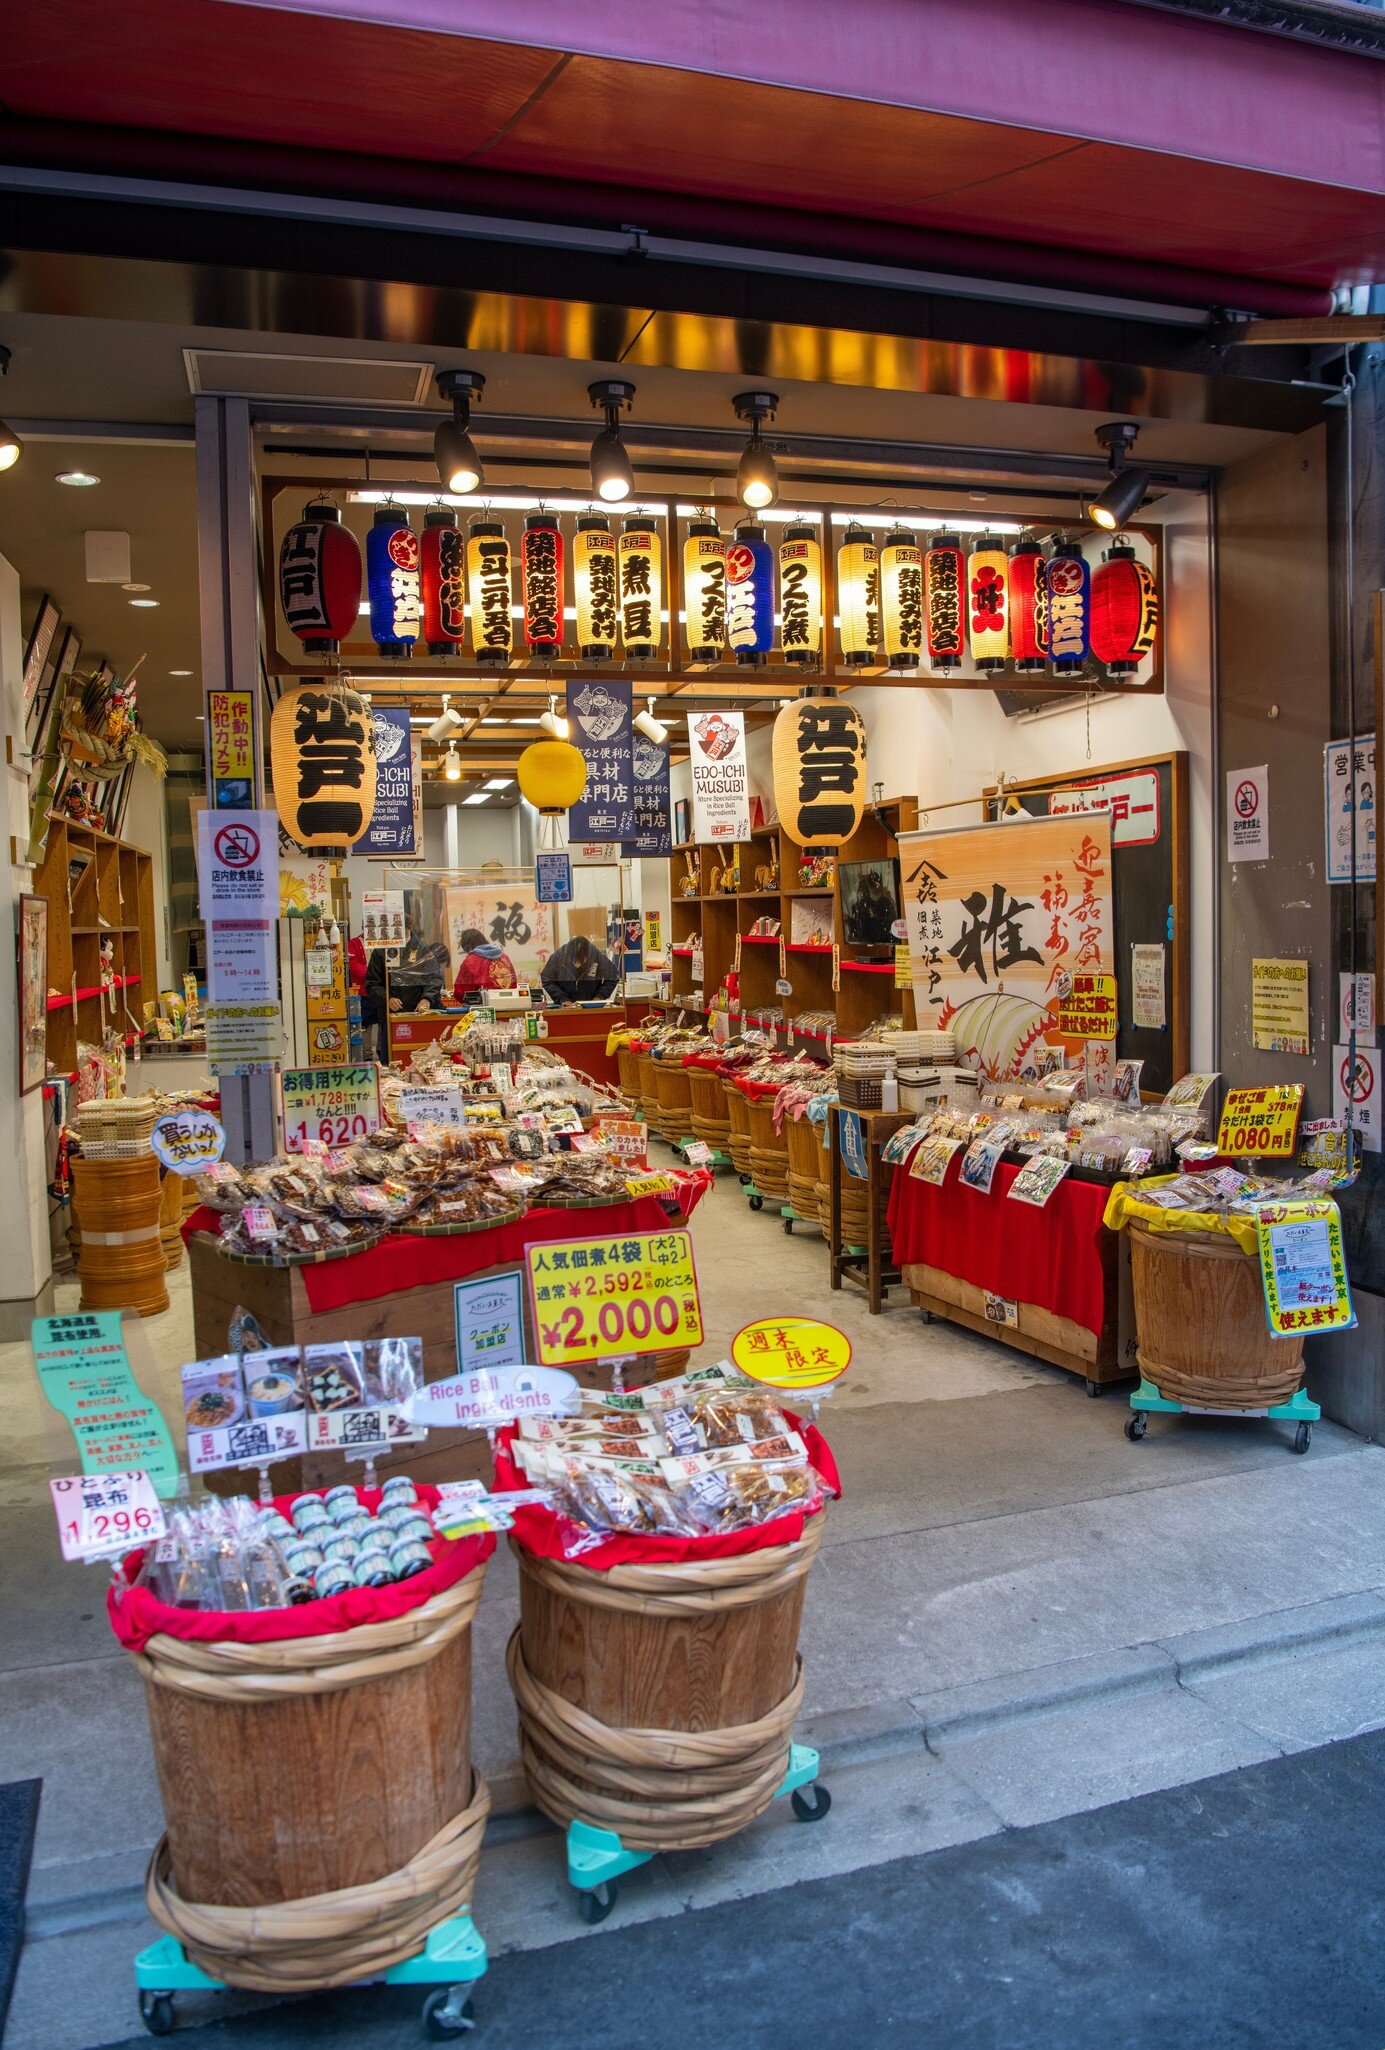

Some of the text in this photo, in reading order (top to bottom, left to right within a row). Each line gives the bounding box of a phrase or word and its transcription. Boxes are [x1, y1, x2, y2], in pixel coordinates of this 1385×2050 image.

[478, 542, 511, 646] 一斗二升五合
[526, 532, 559, 639] 築地銘店会
[623, 555, 652, 639] 煮豆
[783, 563, 809, 646] つくだ煮
[930, 552, 959, 652] 築地銘店会
[213, 695, 231, 776] 防犯カメラ
[294, 692, 365, 838] 江戸一
[376, 767, 410, 781] -ICHI
[586, 762, 620, 780] 具材
[693, 765, 745, 779] EDO-ICHI
[797, 706, 859, 839] 江戸一
[377, 783, 409, 797] SUBI
[579, 783, 628, 804] 専門店
[696, 780, 744, 794] MUSUBI
[634, 796, 660, 811] 具材
[713, 795, 744, 803] Specializing
[589, 816, 616, 828] 江戸一
[634, 812, 667, 828] 門店
[711, 825, 734, 836] 江戸一
[211, 869, 264, 882] 店内飲食禁止
[649, 922, 657, 948] 加盟店
[930, 909, 944, 940] 築地
[947, 883, 1045, 985] 雅
[921, 945, 945, 1005] 江戸一
[206, 1005, 280, 1019] ガイドの方へのお願い
[312, 1053, 345, 1063] おにぎり
[284, 1068, 373, 1092] お得用サイズ
[1228, 1090, 1266, 1105] まぜご飯
[1344, 1106, 1370, 1124] 禁煙
[158, 1121, 217, 1145] 買うしか
[288, 1114, 367, 1148] ¥1620
[632, 1178, 667, 1194] 人気No.1
[1259, 1201, 1331, 1226] 紙クーポン
[534, 1235, 676, 1273] 人気佃煮4袋 大2
[658, 1251, 679, 1266] 中2
[1328, 1222, 1347, 1299] ただいま東京
[1260, 1226, 1279, 1316] アプリも使えます。
[1298, 1281, 1335, 1294] 紙クーポン
[47, 1316, 98, 1329] 北海道産
[541, 1292, 698, 1348] ¥2,000 (税込)
[1279, 1305, 1349, 1331] 使えます。
[470, 1322, 509, 1340] クーポン
[476, 1333, 506, 1349] 加盟店
[747, 1328, 795, 1351] 週末
[785, 1347, 837, 1368] 限定
[430, 1384, 463, 1401] Rice
[54, 1470, 143, 1493] ひとふり
[83, 1489, 129, 1509] 昆布
